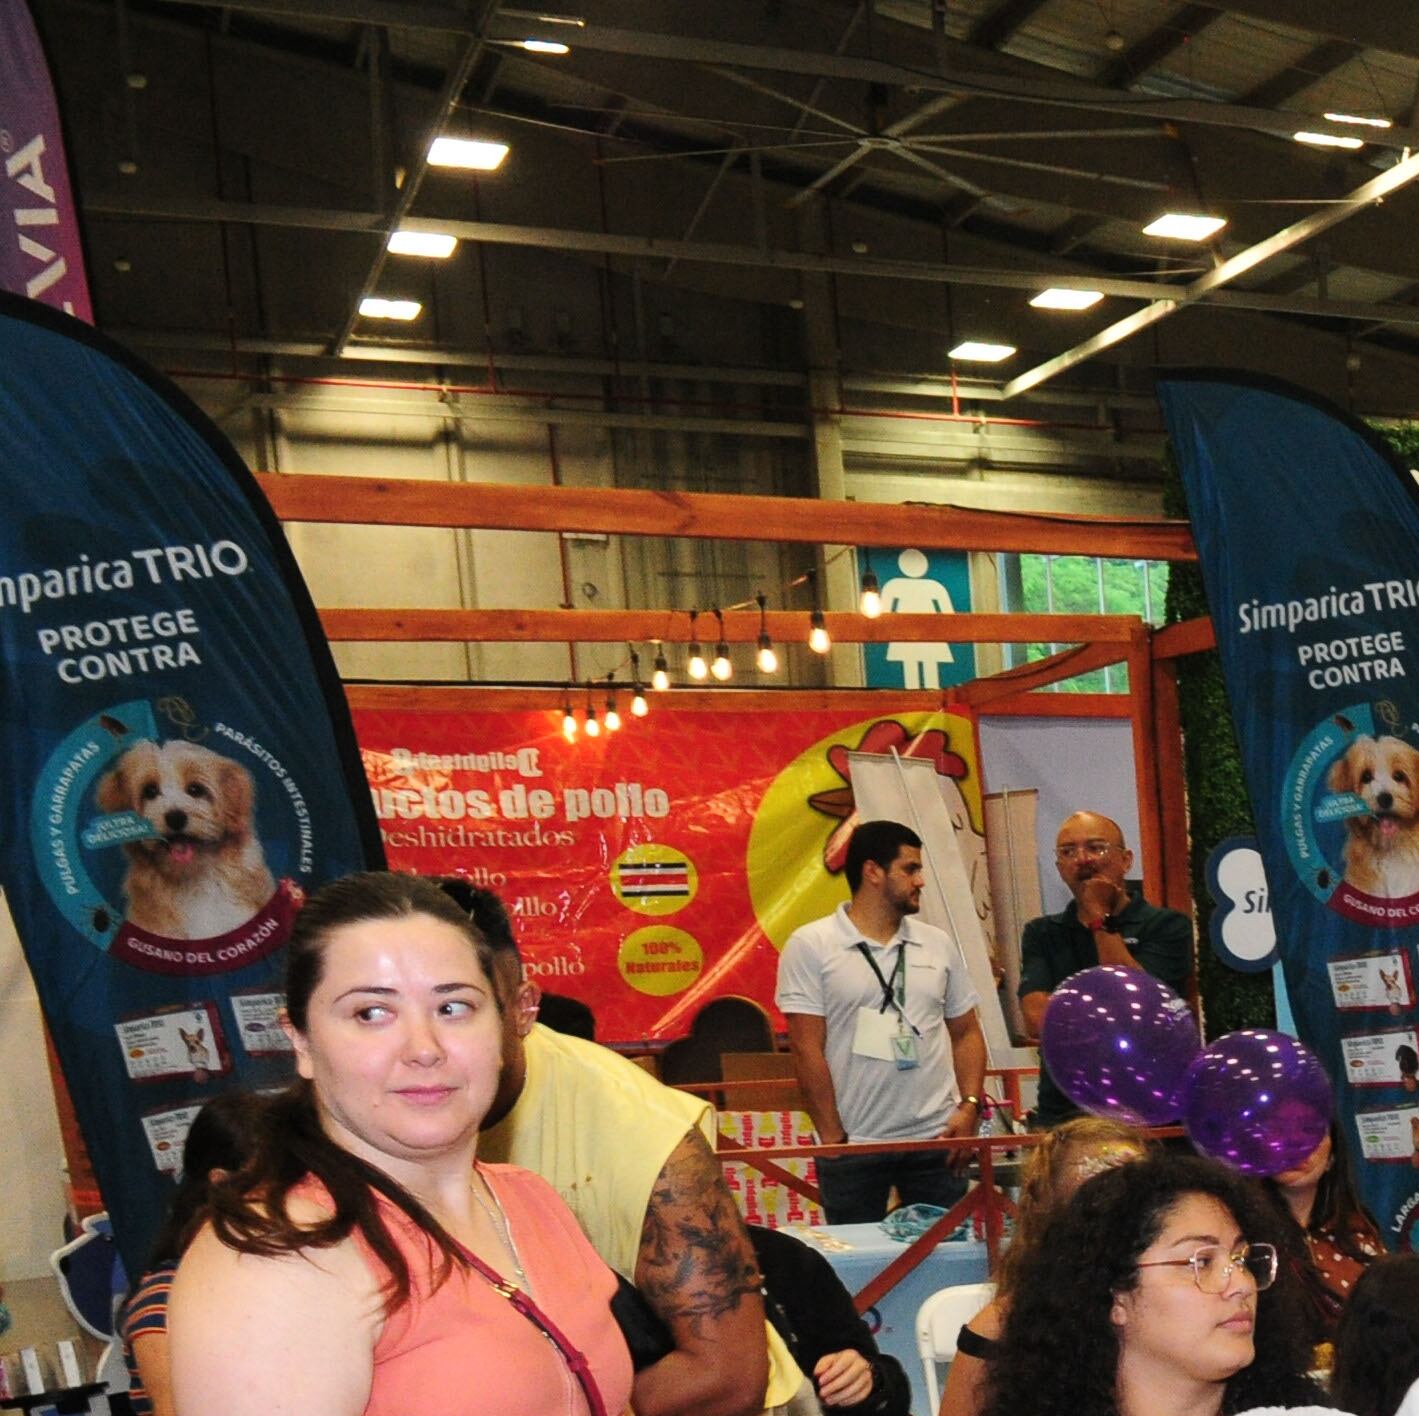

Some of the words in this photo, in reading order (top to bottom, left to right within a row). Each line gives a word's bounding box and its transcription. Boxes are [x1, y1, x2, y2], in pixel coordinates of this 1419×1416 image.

[37, 608, 199, 655] PROTEGE
[1298, 631, 1406, 666] PROTEGE
[57, 641, 202, 684] CONTRA
[1309, 656, 1407, 690] CONTRA
[49, 741, 100, 824] GARRAPATAS
[214, 722, 288, 778] PARÁSITOS
[281, 777, 313, 873] INTESTINALES
[500, 784, 555, 819] de
[563, 783, 671, 823] pollo
[51, 836, 80, 895] PULGAS
[1343, 893, 1386, 918] GUSANO
[1387, 906, 1407, 918] DEL
[126, 936, 184, 964] GUSANO
[185, 951, 216, 964] DEL
[216, 918, 279, 961] CORAZÓN
[521, 956, 586, 982] pollo
[625, 959, 699, 975] Naturales
